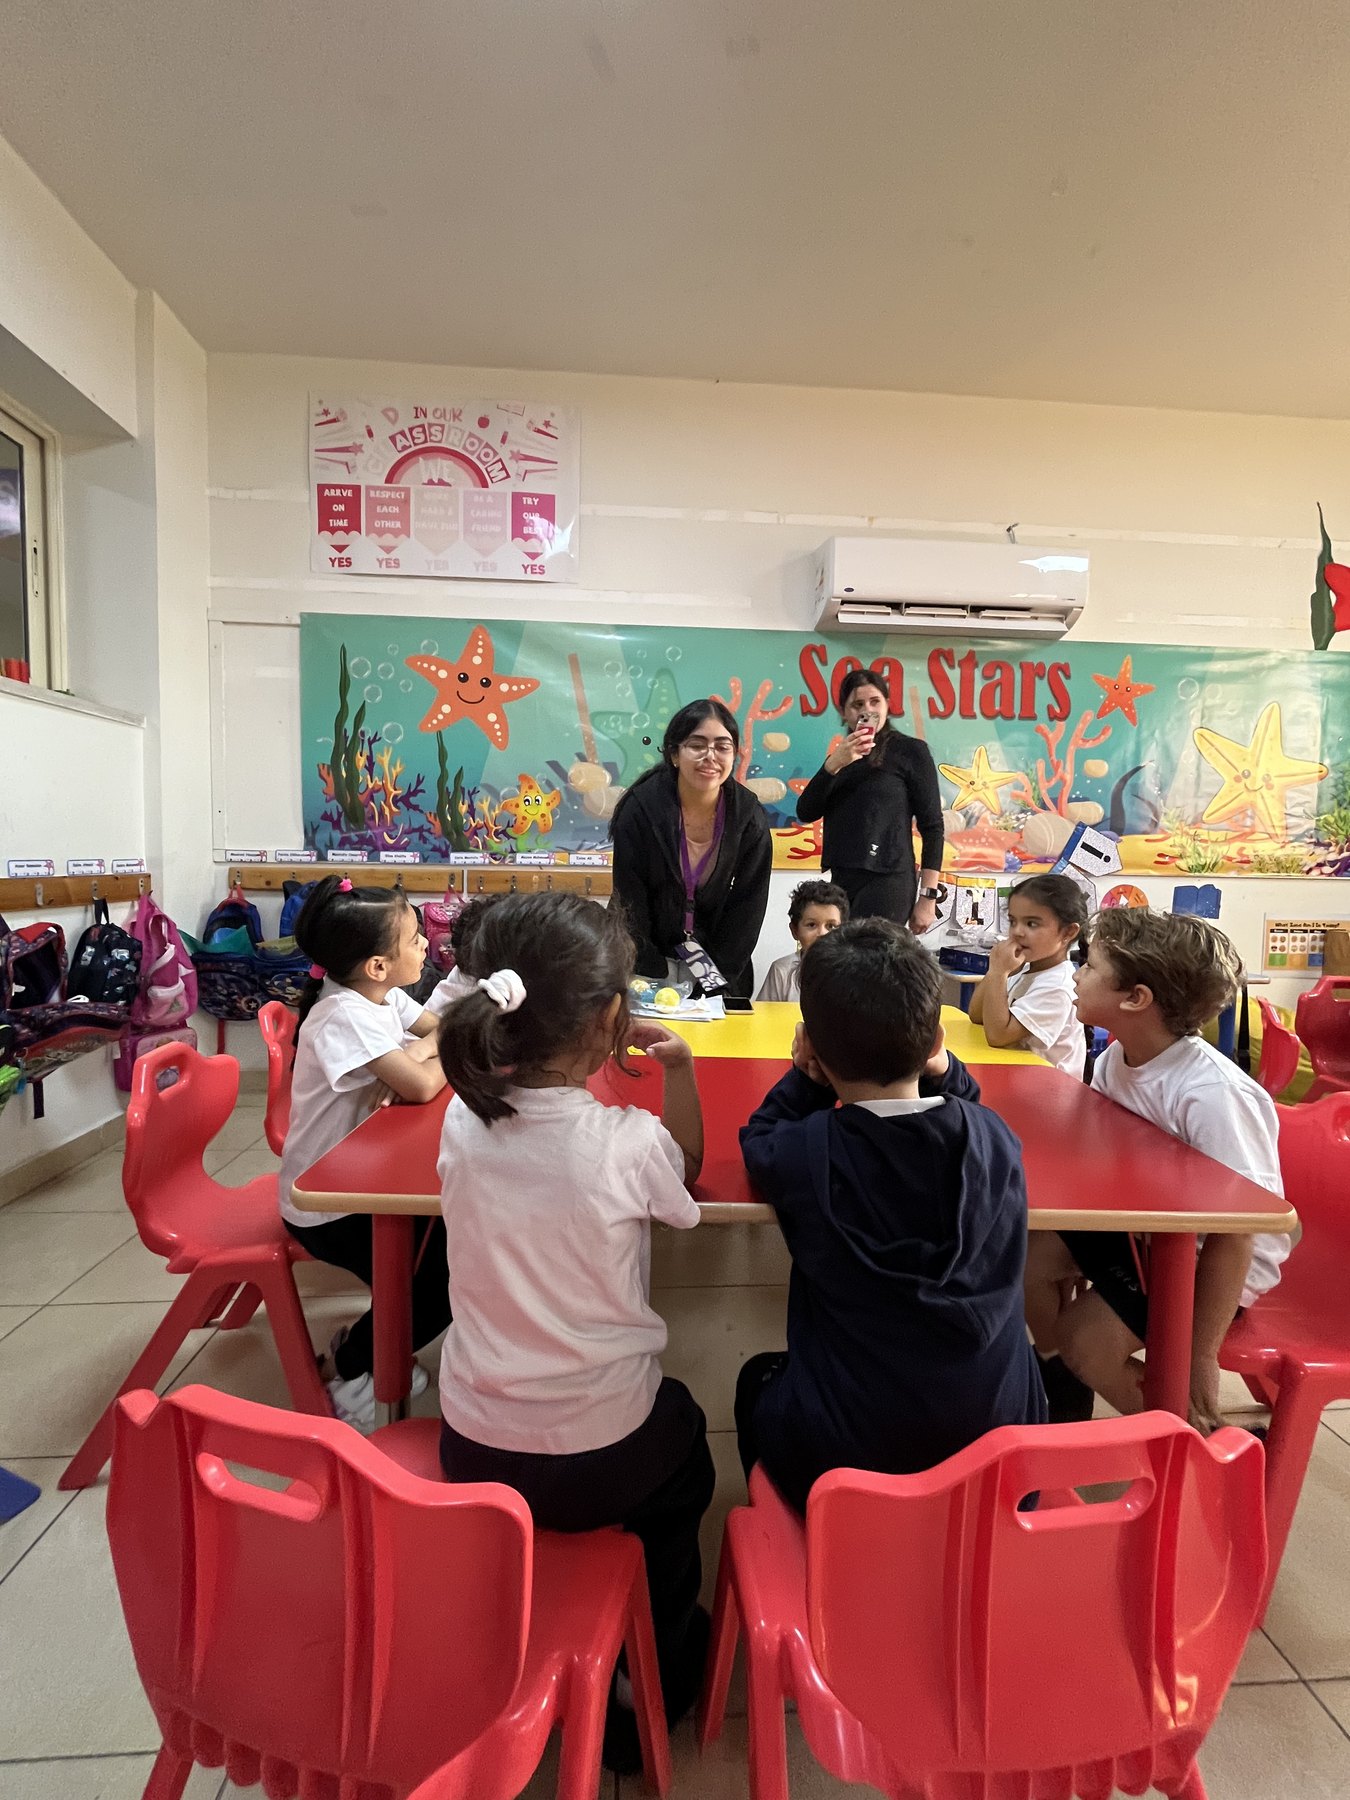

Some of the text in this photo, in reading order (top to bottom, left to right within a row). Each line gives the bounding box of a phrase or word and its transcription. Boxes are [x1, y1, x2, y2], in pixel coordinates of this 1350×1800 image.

[413, 406, 428, 419] IN
[369, 490, 405, 499] RESPECT
[522, 496, 540, 506] TRY
[332, 504, 345, 512] ON
[376, 505, 400, 514] EACH
[328, 519, 349, 527] TIME
[374, 520, 402, 529] OTHER
[328, 557, 353, 568] YES
[376, 557, 401, 569] YES
[521, 563, 546, 575] YES
[927, 647, 1072, 721] Stars
